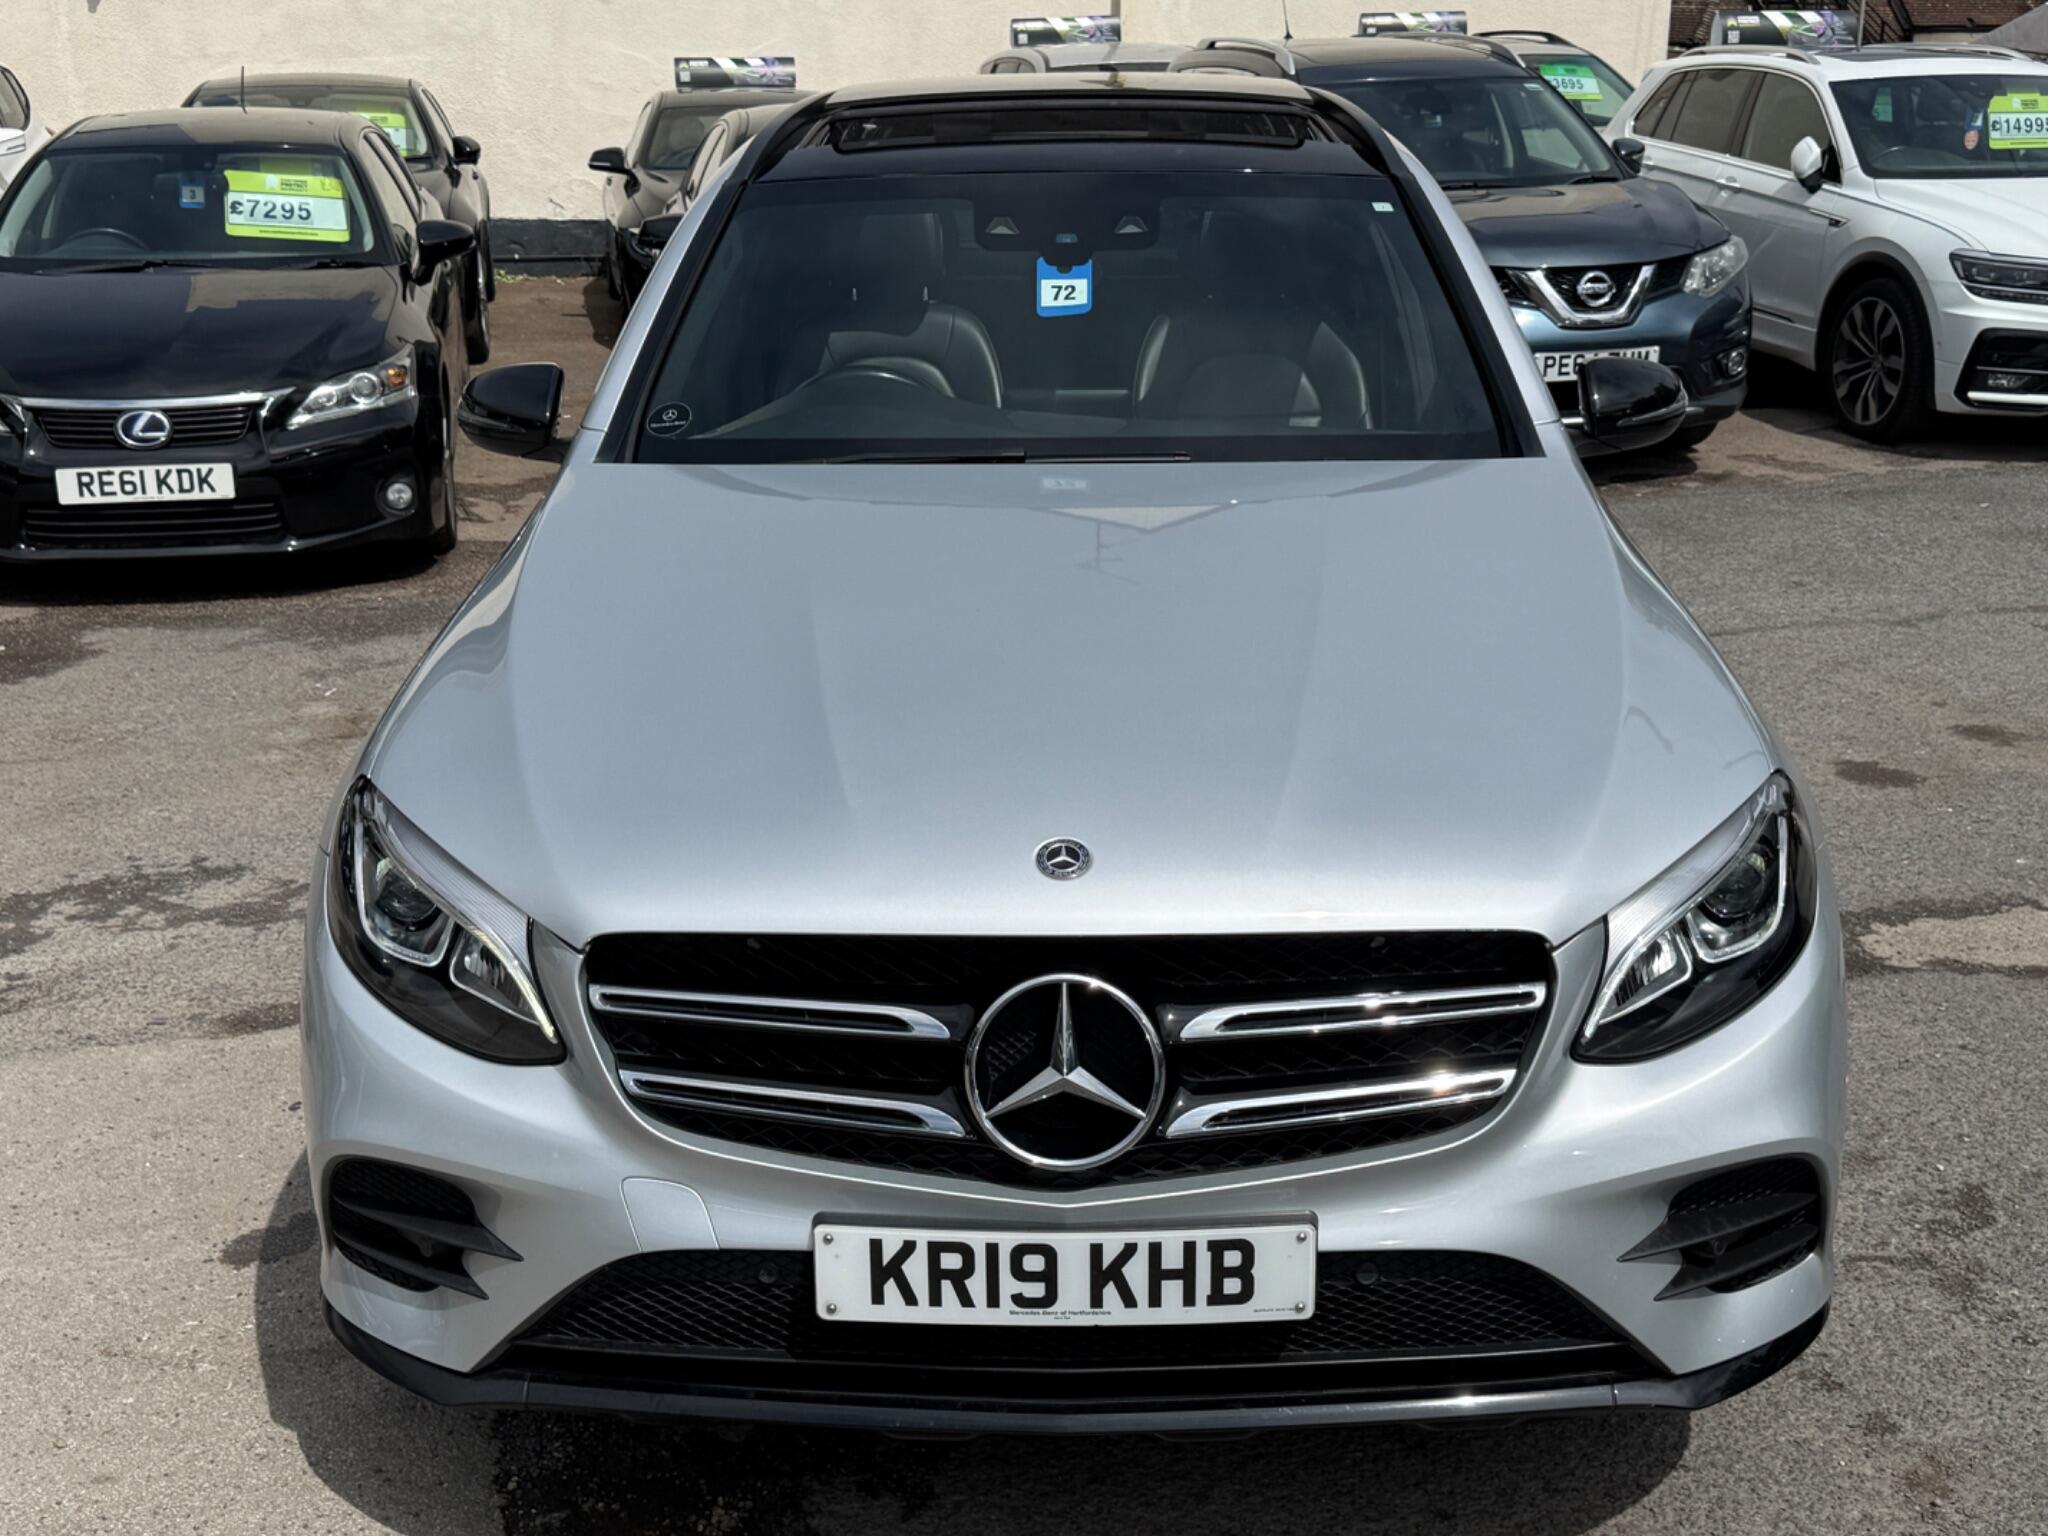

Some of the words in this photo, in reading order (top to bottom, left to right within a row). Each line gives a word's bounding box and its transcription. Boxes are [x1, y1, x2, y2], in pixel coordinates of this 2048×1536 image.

[1991, 117, 2048, 134] £1499
[229, 199, 312, 221] £7295
[1050, 284, 1077, 301] 72
[76, 470, 147, 498] RE61
[155, 467, 216, 495] KDK
[869, 1238, 1058, 1309] KR19
[1089, 1238, 1255, 1308] KHB
